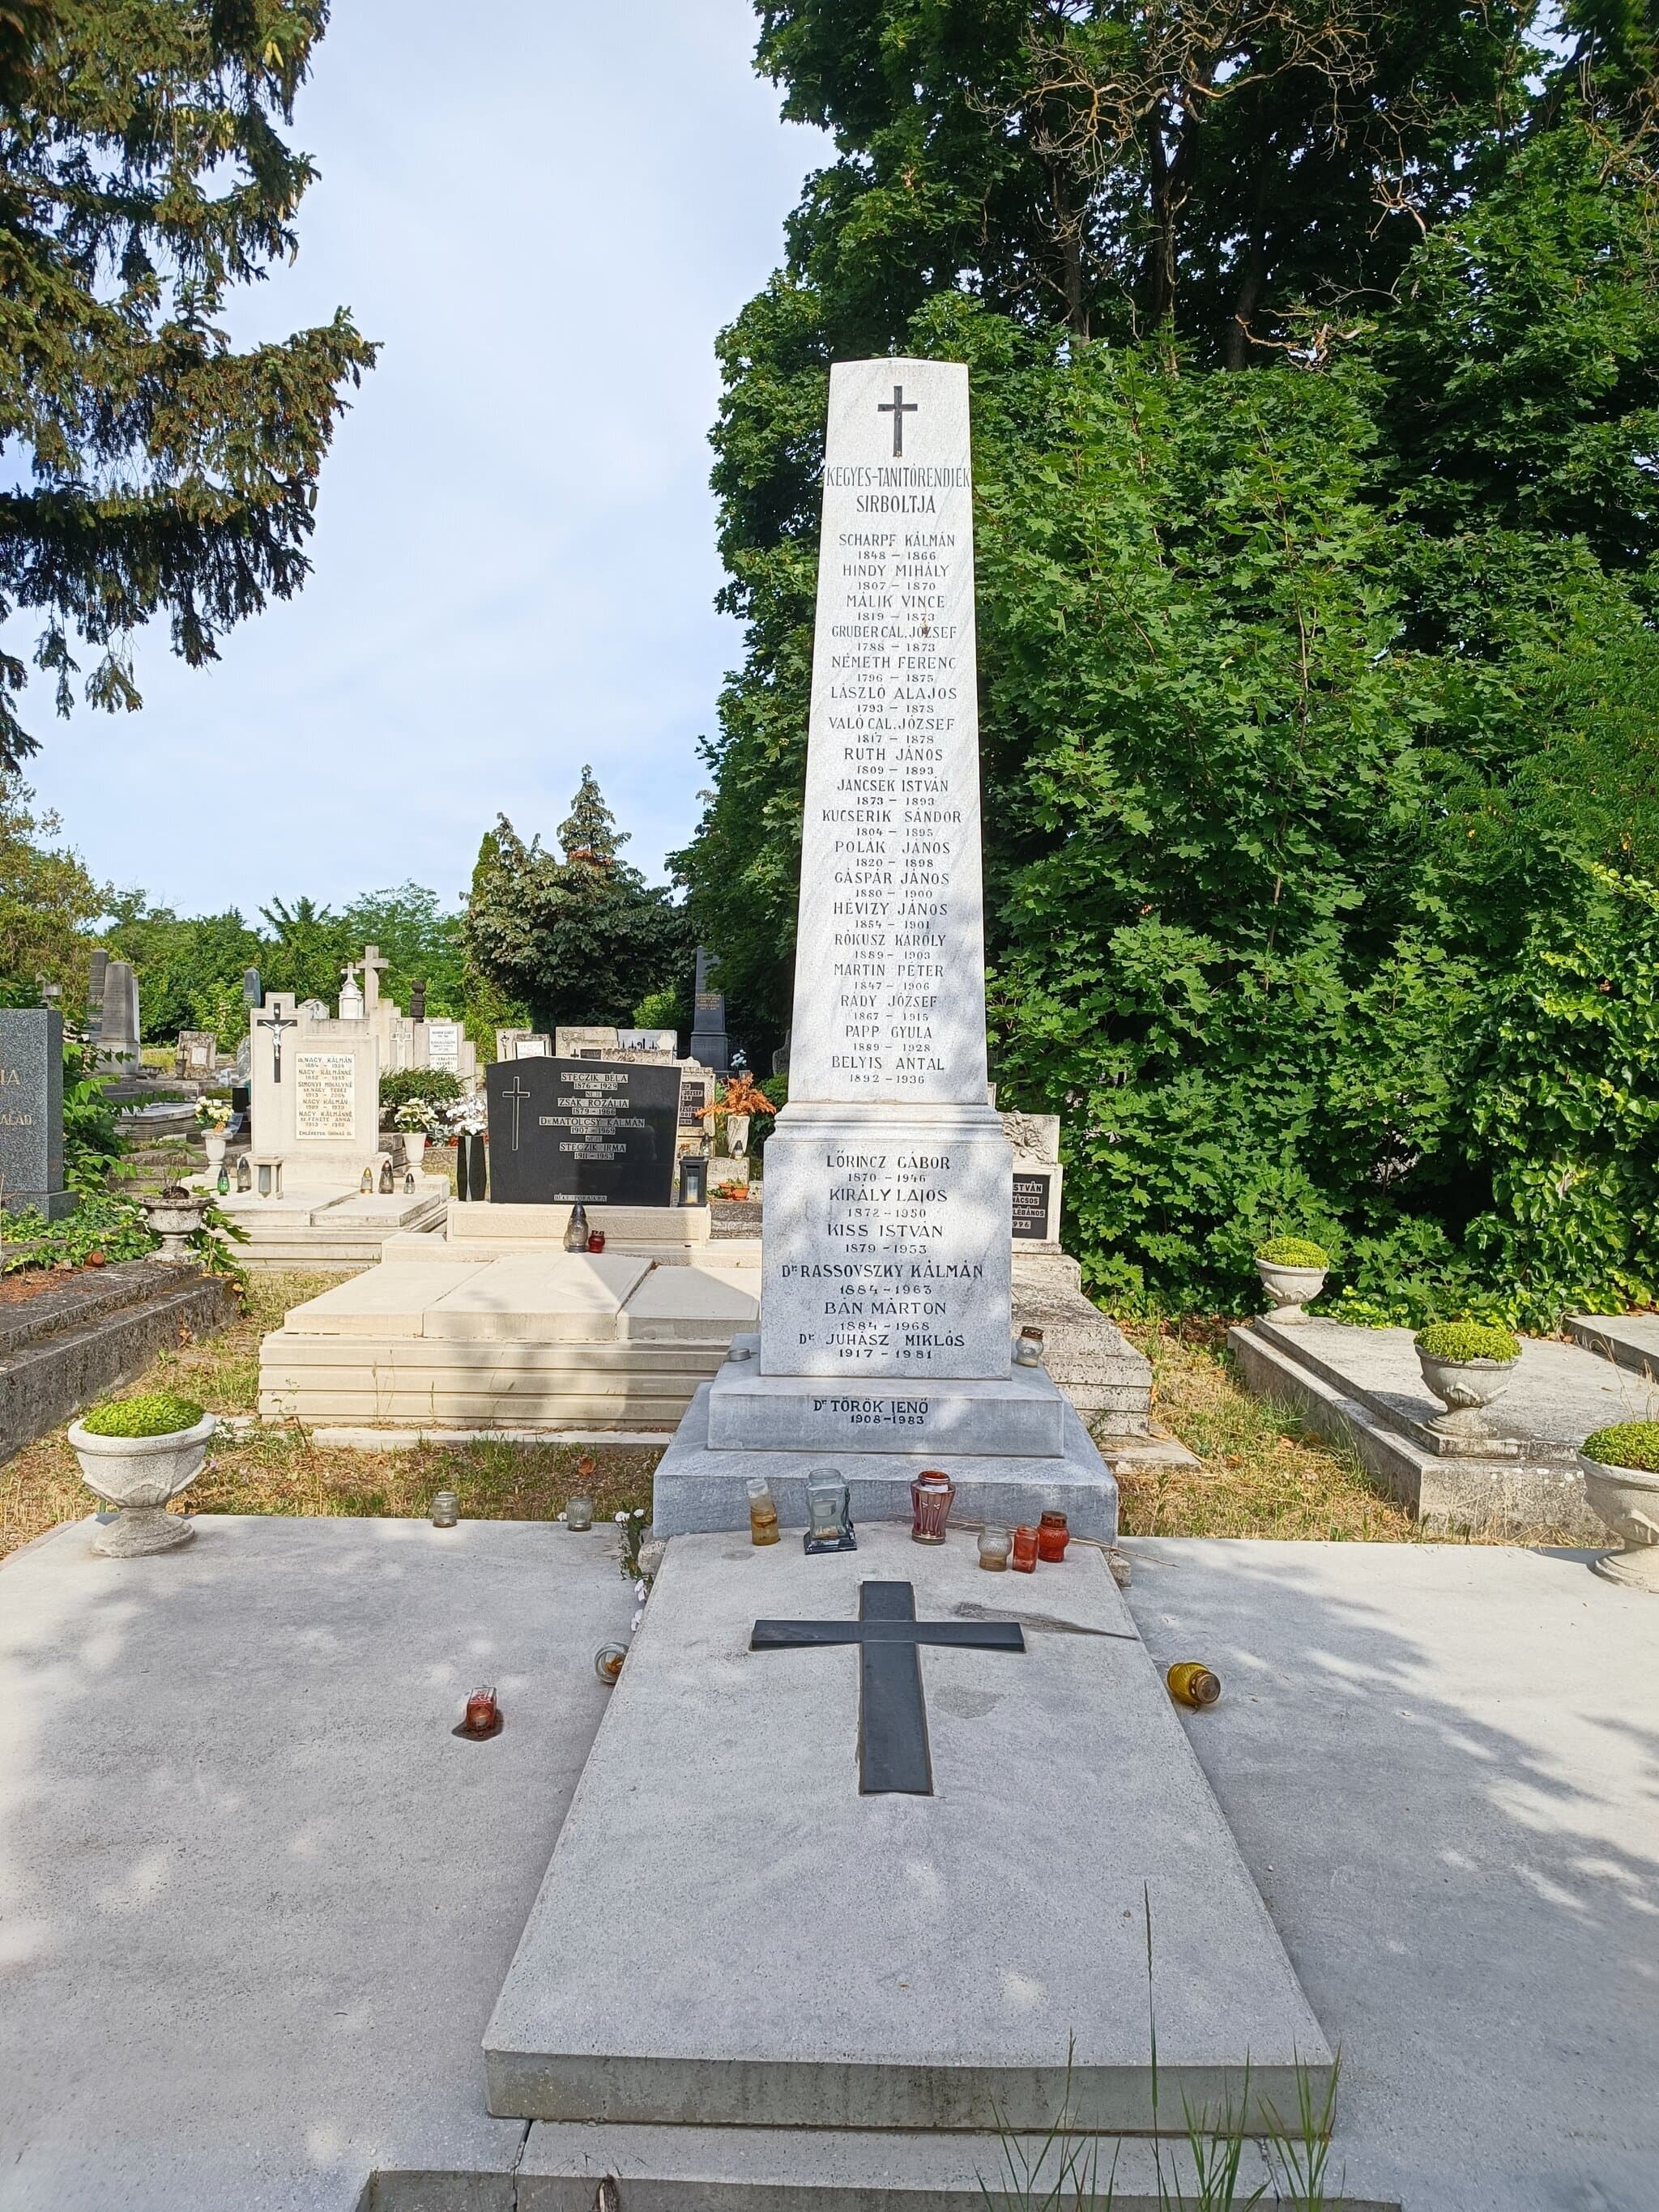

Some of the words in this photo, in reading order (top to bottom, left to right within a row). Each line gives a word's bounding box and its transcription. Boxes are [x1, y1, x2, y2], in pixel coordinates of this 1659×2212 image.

[856, 495, 936, 514] SIRBOLTJA
[839, 534, 896, 547] SCHARPF
[906, 531, 955, 547] KÁLMÁN
[858, 552, 885, 560] 1848
[907, 552, 936, 560] 1866
[843, 565, 886, 577] HINDY
[896, 561, 949, 577] MIHÁLY
[858, 582, 885, 590] 1807
[907, 582, 936, 590] 1870
[847, 591, 893, 608] MÁLIK
[902, 596, 945, 608] VINCE
[858, 612, 884, 620] 1819
[832, 625, 878, 637] GRUBER
[858, 643, 885, 651] 1788
[906, 643, 936, 651] 1873
[832, 653, 890, 668] NÉMETH
[898, 657, 957, 669] FERENC
[858, 674, 883, 682] 1796
[831, 683, 885, 699] LÁSZLÓ
[894, 688, 957, 700] ALAJOS
[858, 705, 883, 713] 1793
[830, 714, 864, 730] VALÓ
[898, 715, 954, 730] JÓZSEF
[858, 735, 882, 743] 1817
[906, 735, 934, 744] 1878
[845, 748, 885, 760] RUTH
[896, 745, 943, 761] JÁNOS
[858, 765, 884, 774] 1809
[906, 766, 934, 774] 1893
[837, 780, 894, 791] JANCSEK
[902, 776, 949, 791] ISTVÁN
[857, 797, 883, 805] 1873
[906, 797, 935, 805] 1893
[822, 810, 891, 822] KUCSERIK
[905, 807, 962, 823] SÁNDOR
[857, 828, 883, 836] 1804
[906, 829, 933, 837] 1895
[835, 837, 885, 853] POLÁK
[902, 838, 950, 854] JÁNOS
[856, 859, 883, 867] 1820
[834, 867, 892, 884] GÁSPÁR
[901, 868, 949, 884] JÁNOS
[856, 889, 882, 897] 1880
[906, 890, 932, 898] 1900
[834, 898, 889, 914] HÉVIZY
[898, 899, 948, 915] JÁNOS
[855, 920, 881, 928] 1854
[835, 930, 885, 945] RÓKUSZ
[895, 931, 946, 946] KÁROLY
[855, 951, 884, 959] 1889
[904, 952, 931, 960] 1903
[834, 964, 885, 976] MARTIN
[898, 961, 944, 977] PÉTER
[855, 982, 881, 990] 1847
[889, 992, 937, 1008] JÓZSEF
[903, 1013, 928, 1021] 1915
[846, 1025, 880, 1037] PAPP
[891, 1026, 932, 1038] GYULA
[854, 1042, 880, 1051] 1889
[832, 1056, 882, 1068] BELYIS
[896, 1058, 945, 1071] ANTAL
[605, 1072, 627, 1082] BÉLA
[851, 1074, 880, 1082] 1892
[897, 1076, 924, 1084] 1936
[559, 1096, 582, 1106] ZSÁK
[588, 1097, 628, 1107] ROZÁLIA
[552, 1118, 601, 1126] MATOLCSY
[609, 1116, 644, 1127] KÁLMÁN
[898, 1152, 950, 1169] GÁBOR
[849, 1174, 876, 1182] 1870
[898, 1174, 925, 1183] 1946
[1013, 1182, 1042, 1192] STVÁN
[830, 1184, 891, 1201] KIRÁLY
[898, 1189, 948, 1204] LAJOS
[849, 1208, 880, 1217] 1872
[896, 1209, 926, 1218] 1950
[1013, 1207, 1044, 1217] LÉBÁNOS
[828, 1224, 868, 1236] KISS
[880, 1221, 942, 1238] ISTVÁN
[846, 1244, 876, 1253] 1879
[894, 1245, 926, 1254] 1953
[801, 1264, 903, 1277] RASSOVSZKY
[911, 1260, 983, 1278] KÁLMÁN
[840, 1285, 877, 1294] 1884
[895, 1285, 931, 1294] 1963
[825, 1298, 863, 1314] BÁN
[872, 1298, 946, 1315] MÁRTON
[841, 1322, 876, 1330] 1884
[896, 1322, 929, 1330] 1968
[826, 1331, 889, 1345] JUHÁSZ
[906, 1330, 965, 1346] MIKLÓS
[839, 1349, 873, 1357] 1917
[896, 1349, 932, 1358] 1981
[831, 1396, 885, 1413] TÖRÖK
